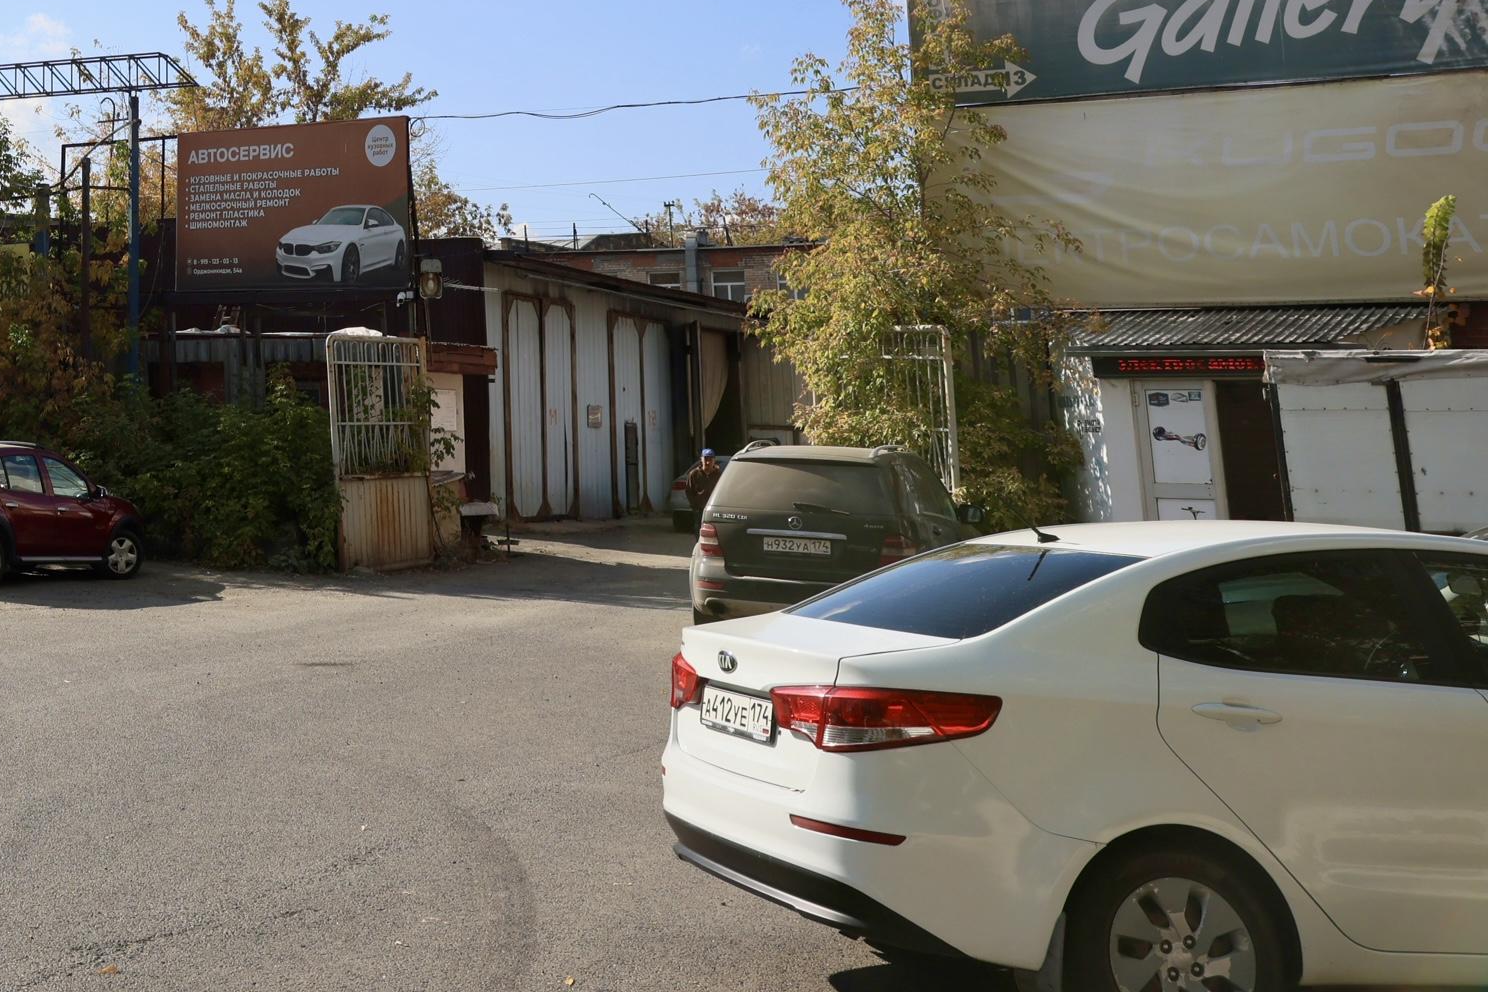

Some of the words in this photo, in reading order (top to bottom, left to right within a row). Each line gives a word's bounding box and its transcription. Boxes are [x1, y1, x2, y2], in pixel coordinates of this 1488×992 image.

[1013, 70, 1027, 86] 3
[1142, 120, 1488, 168] KUGO
[188, 143, 294, 165] АВТОСЕРВИС
[190, 174, 231, 184] КУЗОВНЫЕ
[233, 173, 239, 181] И
[241, 169, 302, 181] ПОКРАСОЧНЫЕ
[304, 168, 340, 177] РАБОТЫ
[190, 183, 241, 193] СТАПЕЛЬНЫЕ
[243, 180, 277, 190] РАБОТЫ
[190, 192, 221, 202] ЗАМЕНА
[223, 191, 250, 200] МАСЛА
[253, 190, 259, 198] И
[261, 188, 301, 198] КОЛОДОК
[190, 199, 255, 211] МЕЛКОСРОЧНЫЙ
[257, 198, 290, 208] РЕМОНТ
[190, 211, 221, 220] РЕМОНТ
[222, 210, 265, 219] ПЛАСТИКА
[189, 219, 248, 230] ШИНОМОНТАЖ
[1002, 213, 1488, 265] ЕКТРОСАМОКА
[767, 539, 809, 552] Н932УА
[812, 540, 829, 550] 174
[705, 694, 748, 727] А412УЕ
[751, 702, 769, 725] 174
